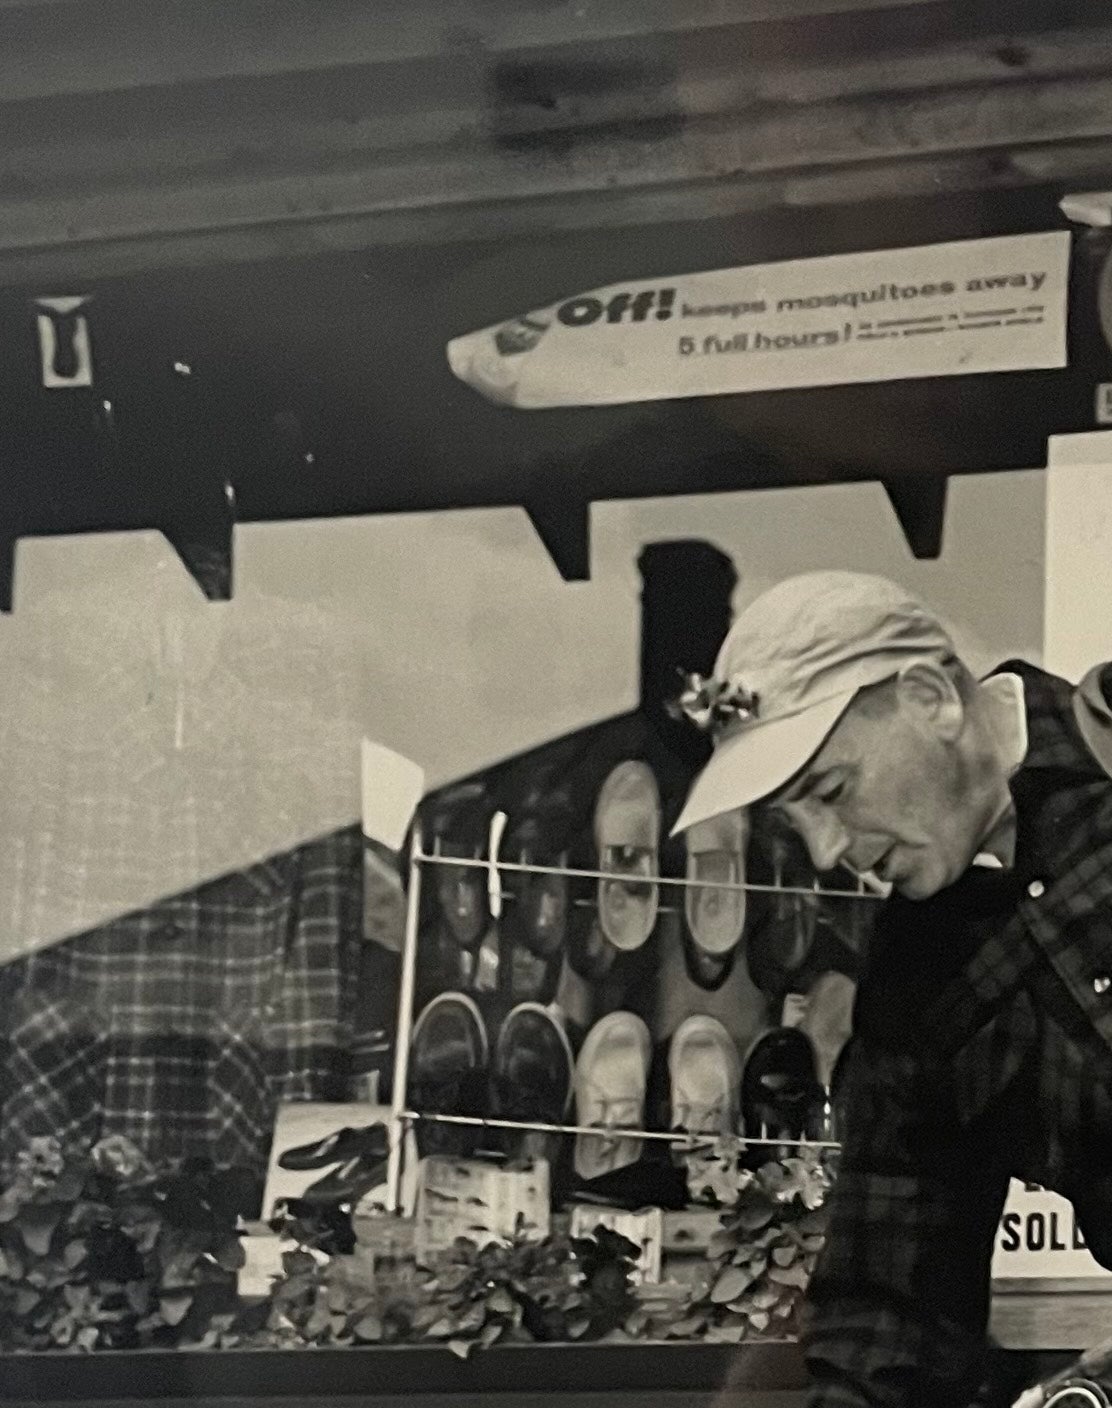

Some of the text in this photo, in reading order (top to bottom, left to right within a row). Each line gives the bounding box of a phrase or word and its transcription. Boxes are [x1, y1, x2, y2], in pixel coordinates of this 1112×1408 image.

[681, 301, 767, 320] keeps
[776, 283, 955, 313] mosquitoes
[965, 272, 1047, 292] away
[678, 335, 696, 357] 5
[702, 332, 749, 355] full
[754, 322, 852, 350] hours!
